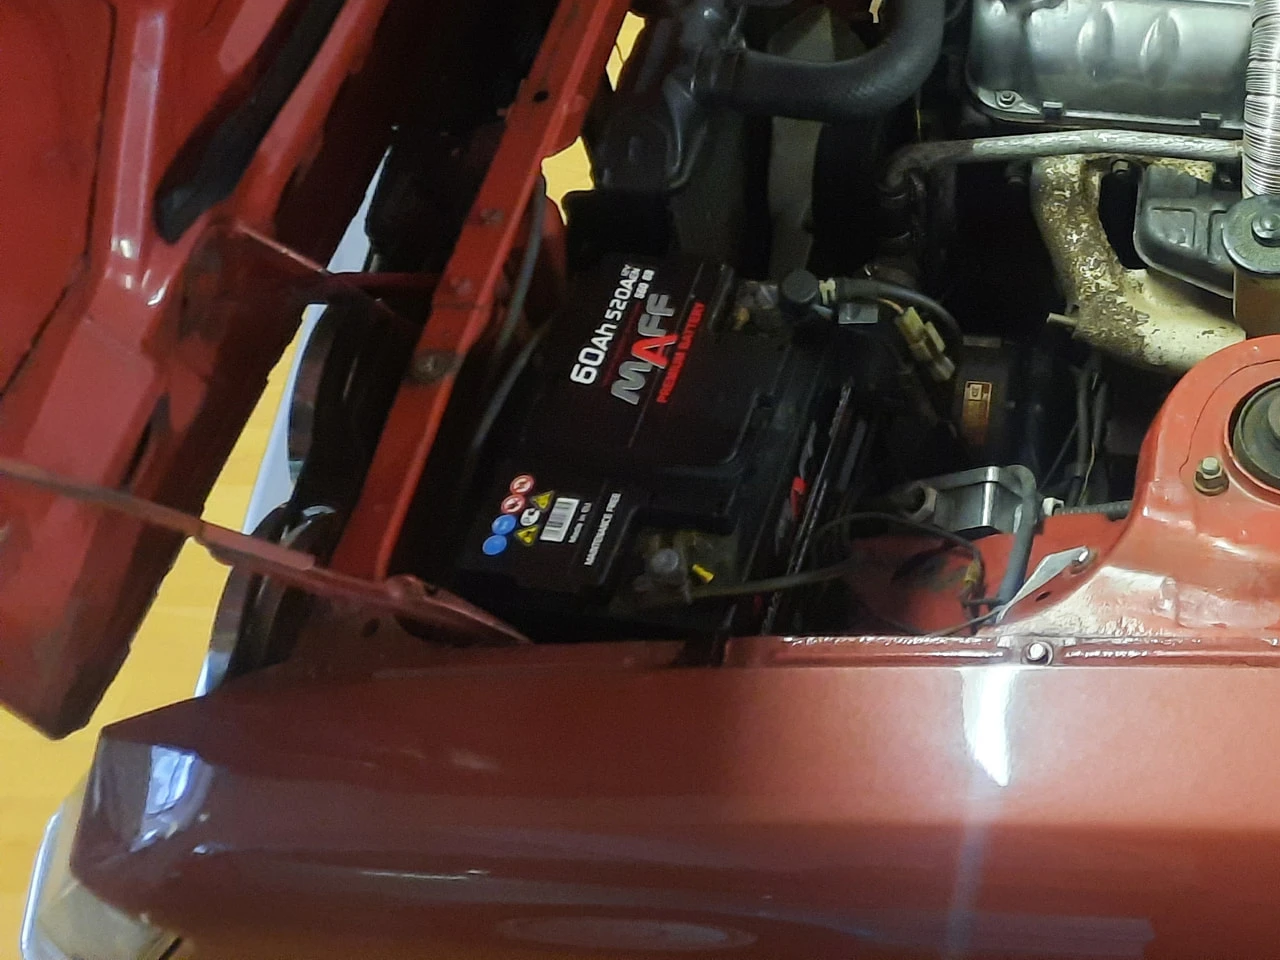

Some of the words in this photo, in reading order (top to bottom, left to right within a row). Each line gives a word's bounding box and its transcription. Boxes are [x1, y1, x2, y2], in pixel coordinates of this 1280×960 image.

[569, 322, 618, 385] 60Ah
[604, 278, 637, 321] 520A
[610, 292, 679, 406] MAFF
[655, 351, 687, 404] PREMIUM
[677, 300, 706, 351] BATTERY
[583, 513, 614, 566] MAINTENANCE
[606, 493, 621, 512] FREE
